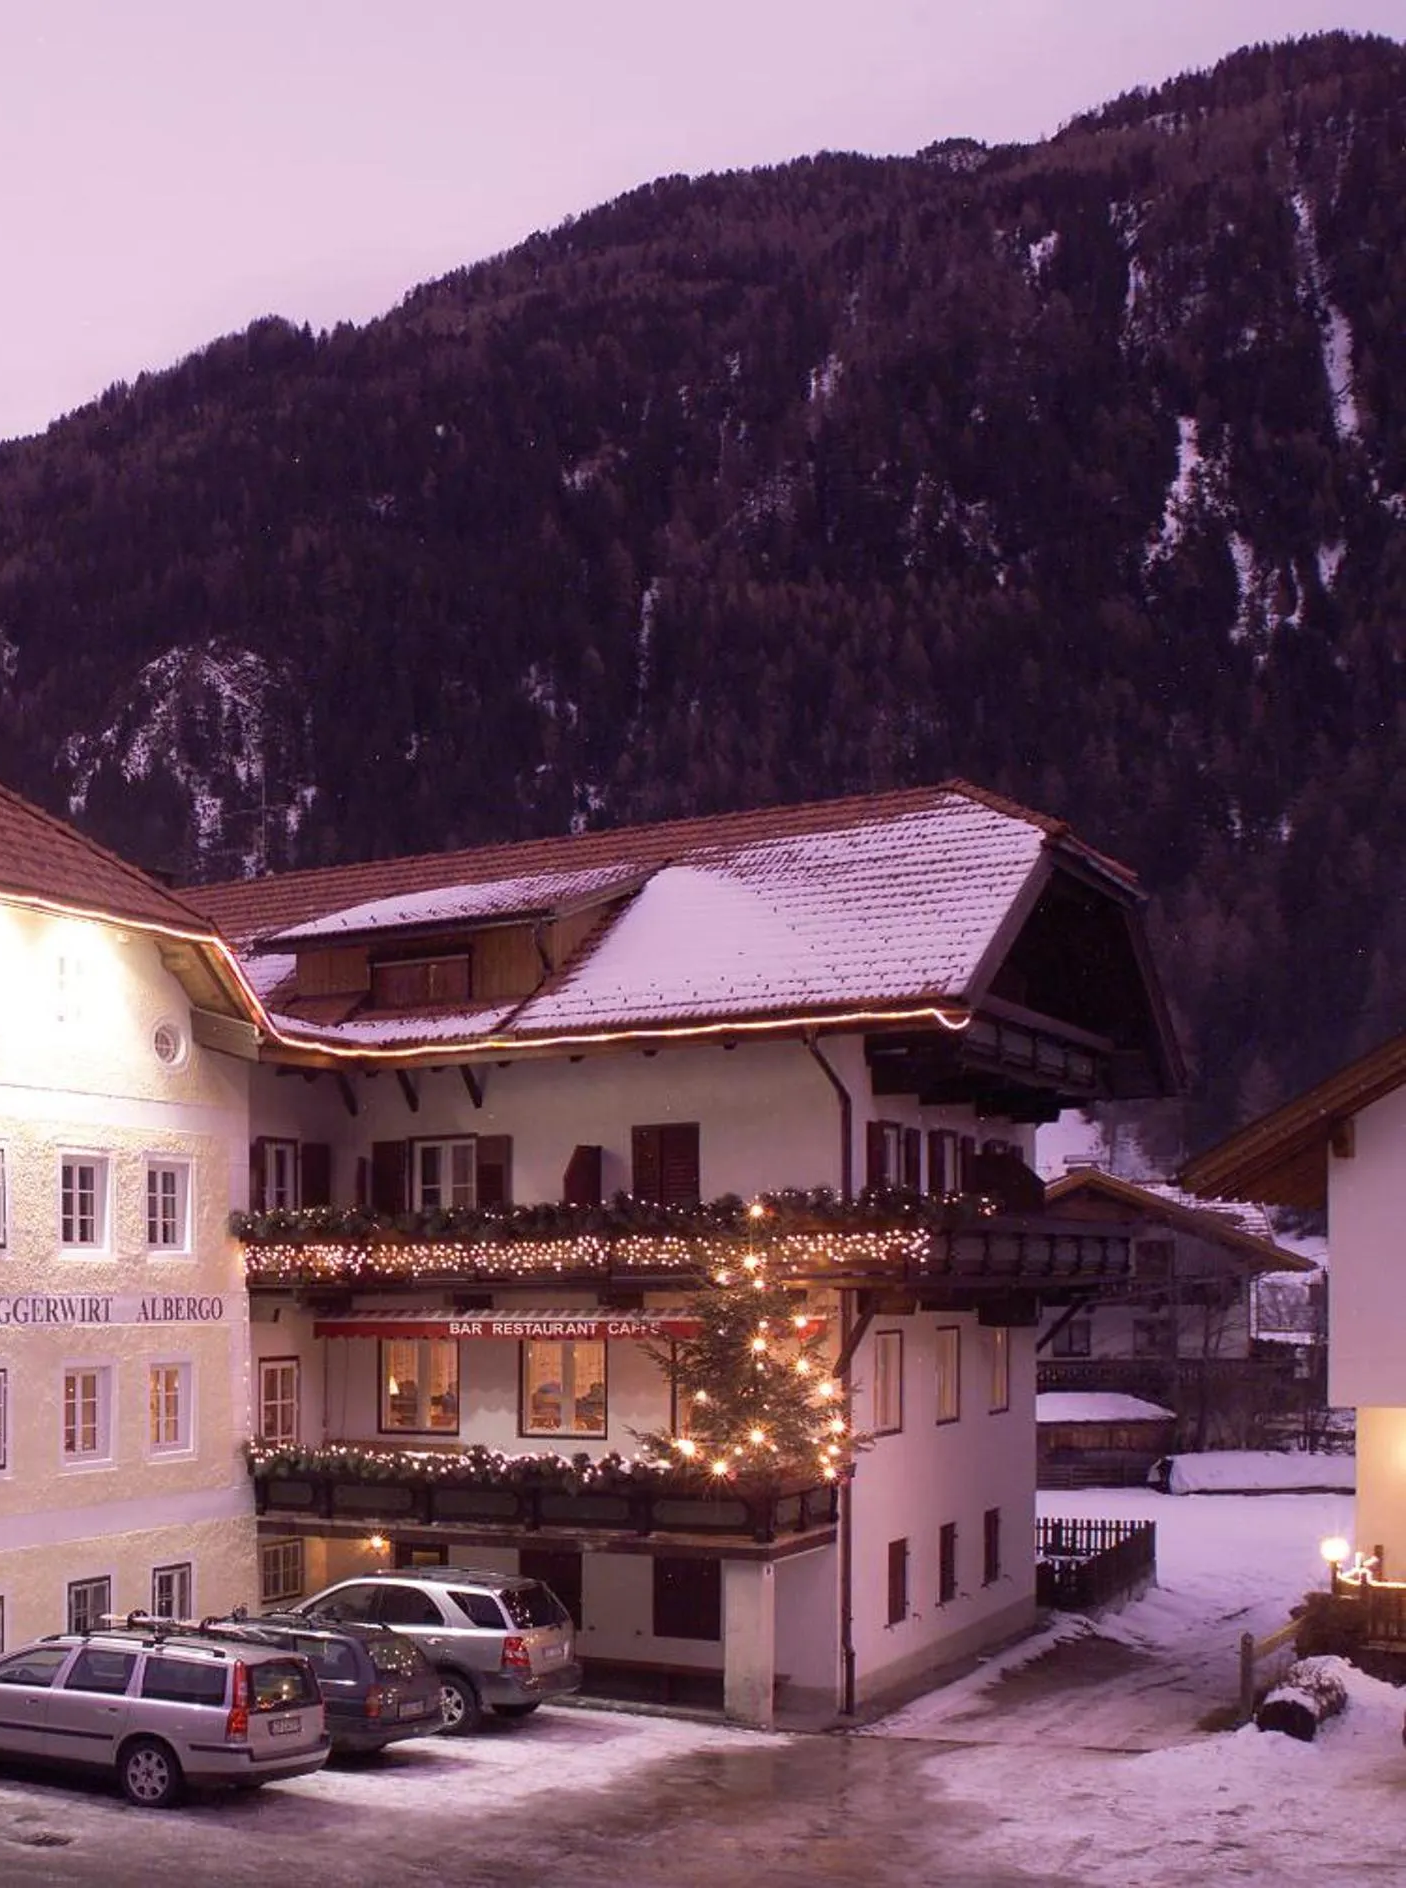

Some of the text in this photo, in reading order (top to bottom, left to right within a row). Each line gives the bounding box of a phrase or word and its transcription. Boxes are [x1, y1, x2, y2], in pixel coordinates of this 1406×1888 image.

[137, 1296, 224, 1321] ALBERGO
[449, 1322, 483, 1335] BAR
[492, 1322, 598, 1335] RESTAURANT
